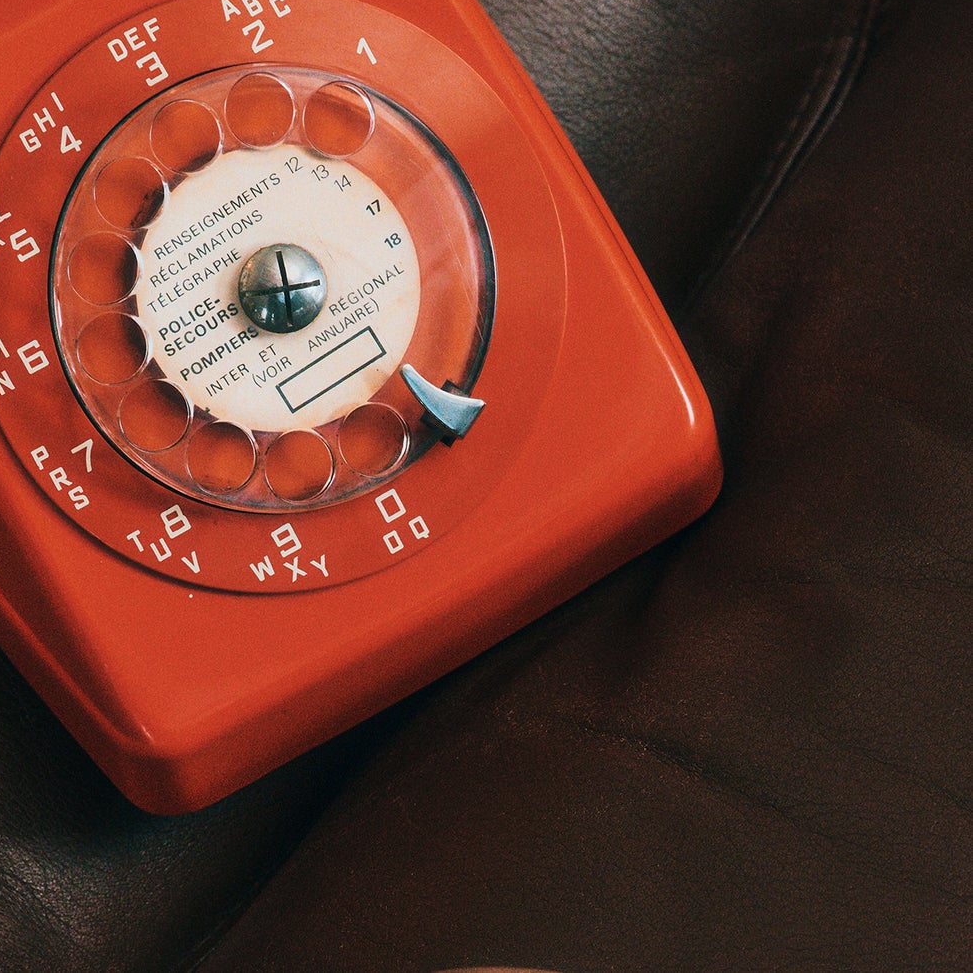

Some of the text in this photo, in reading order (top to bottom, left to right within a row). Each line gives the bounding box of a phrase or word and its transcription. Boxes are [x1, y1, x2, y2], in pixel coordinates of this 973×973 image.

[242, 19, 273, 53] 2
[357, 38, 377, 64] 1
[136, 52, 168, 86] 3
[61, 126, 82, 153] 4
[154, 157, 302, 259] RENSEIGNEMENTS 12
[150, 165, 329, 287] RÉCLAMATIONS 13
[10, 229, 40, 262] 5
[147, 175, 351, 312] TÉLÉGRAPHE 14
[164, 199, 380, 356] SECOURS 17
[159, 297, 220, 340] POLICE-
[180, 233, 401, 381] POMPIERS 18
[206, 265, 404, 396] INTER ET RÉGIONAL
[253, 299, 379, 388] (VOIR ANNUAIRE)
[17, 340, 49, 374] 6
[71, 439, 93, 472] 7
[161, 505, 191, 538] 8
[271, 523, 301, 557] 9
